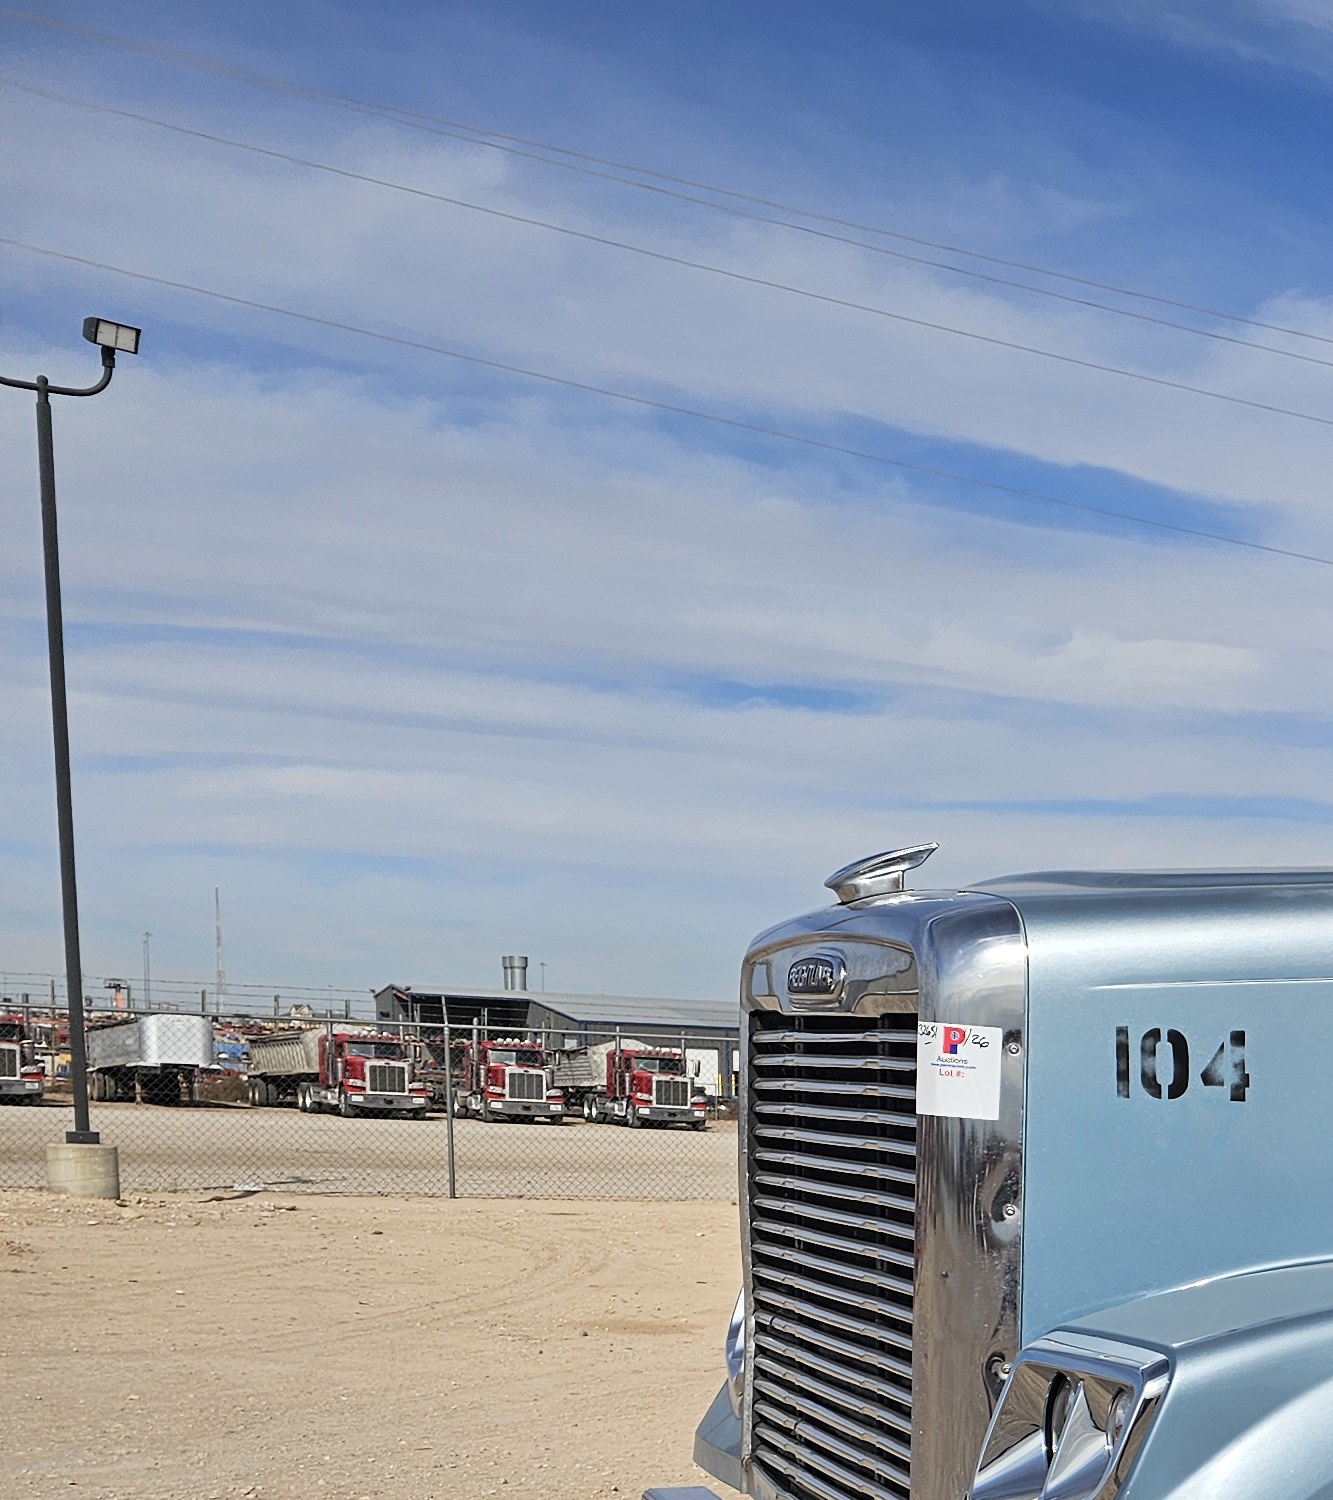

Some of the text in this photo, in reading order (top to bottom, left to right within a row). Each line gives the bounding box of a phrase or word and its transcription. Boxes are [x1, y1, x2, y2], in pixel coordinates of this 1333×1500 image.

[936, 1055, 968, 1065] Auctions
[1115, 1026, 1250, 1102] 104
[939, 1068, 954, 1078] Lot
